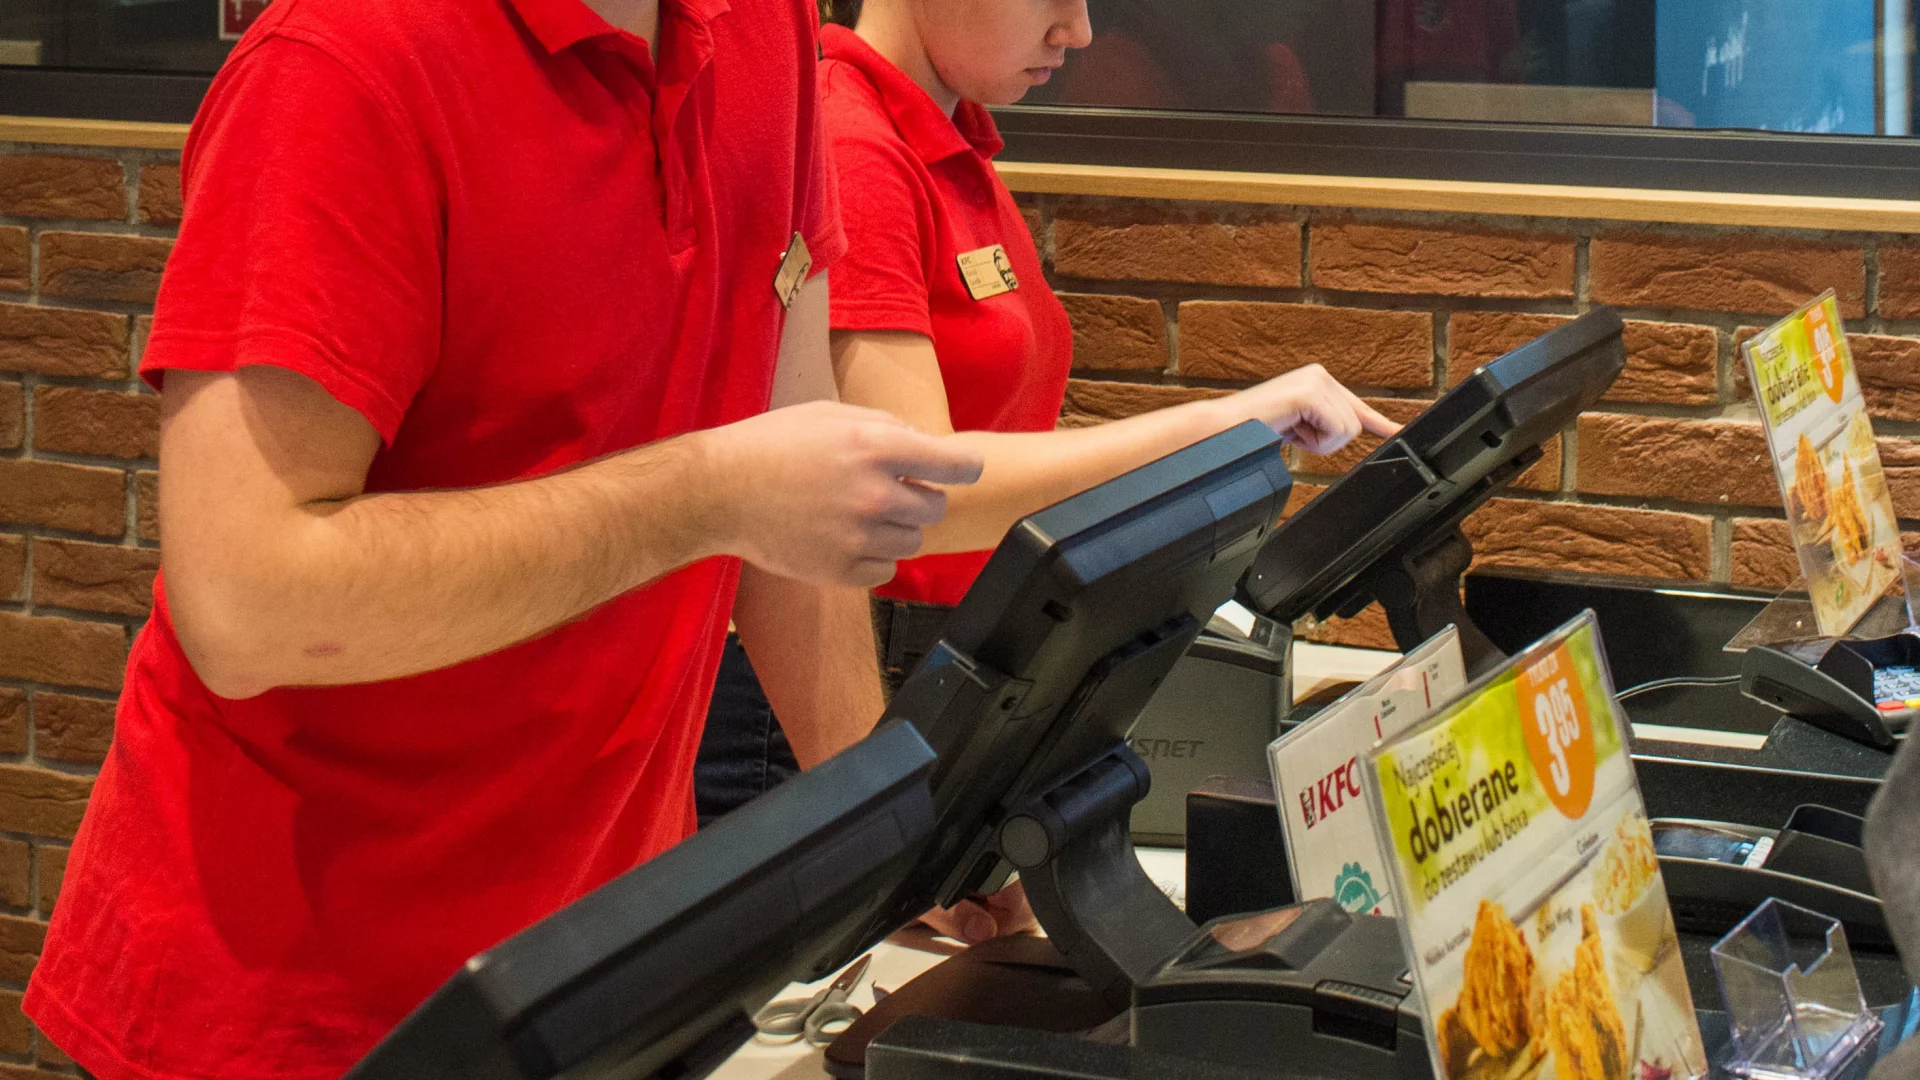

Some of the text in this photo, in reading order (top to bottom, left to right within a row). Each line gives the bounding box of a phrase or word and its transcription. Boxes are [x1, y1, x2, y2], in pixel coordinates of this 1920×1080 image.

[1132, 738, 1204, 760] SNET
[1317, 755, 1361, 821] KFC
[1409, 760, 1520, 864] dobierane
[1424, 810, 1529, 901] do zestawu lub boxa
